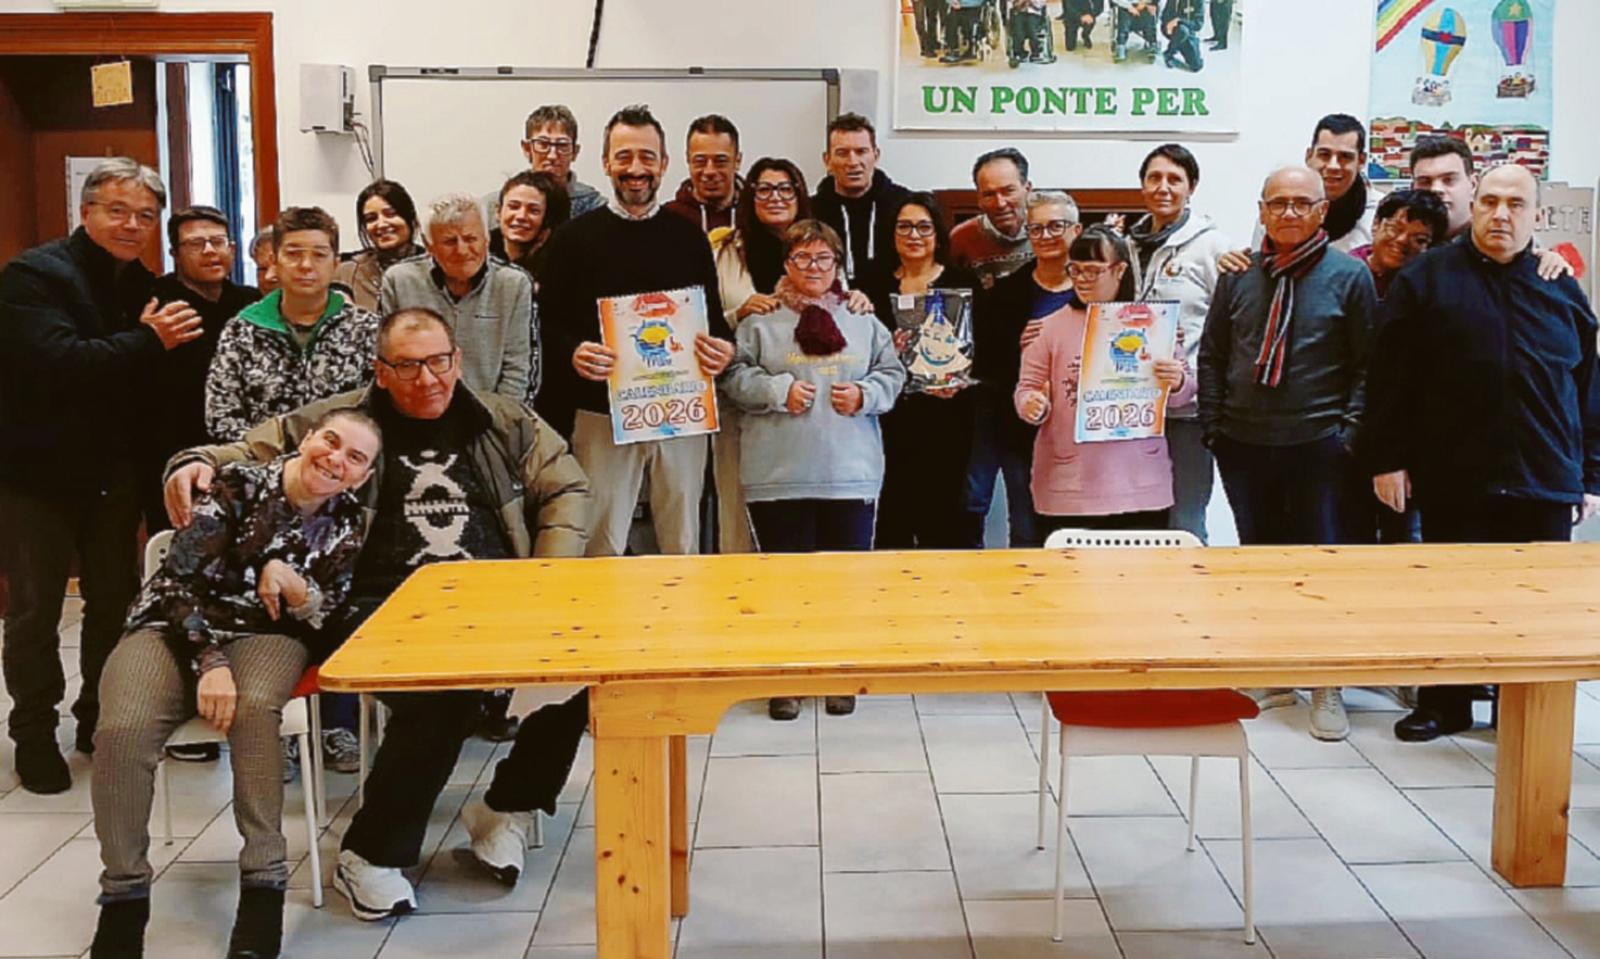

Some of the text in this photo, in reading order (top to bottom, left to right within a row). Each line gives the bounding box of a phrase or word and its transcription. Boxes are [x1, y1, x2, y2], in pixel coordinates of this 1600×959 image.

[922, 85, 1210, 116] UN PONTE PER
[621, 396, 707, 431] 2026
[1084, 402, 1157, 431] 2026
